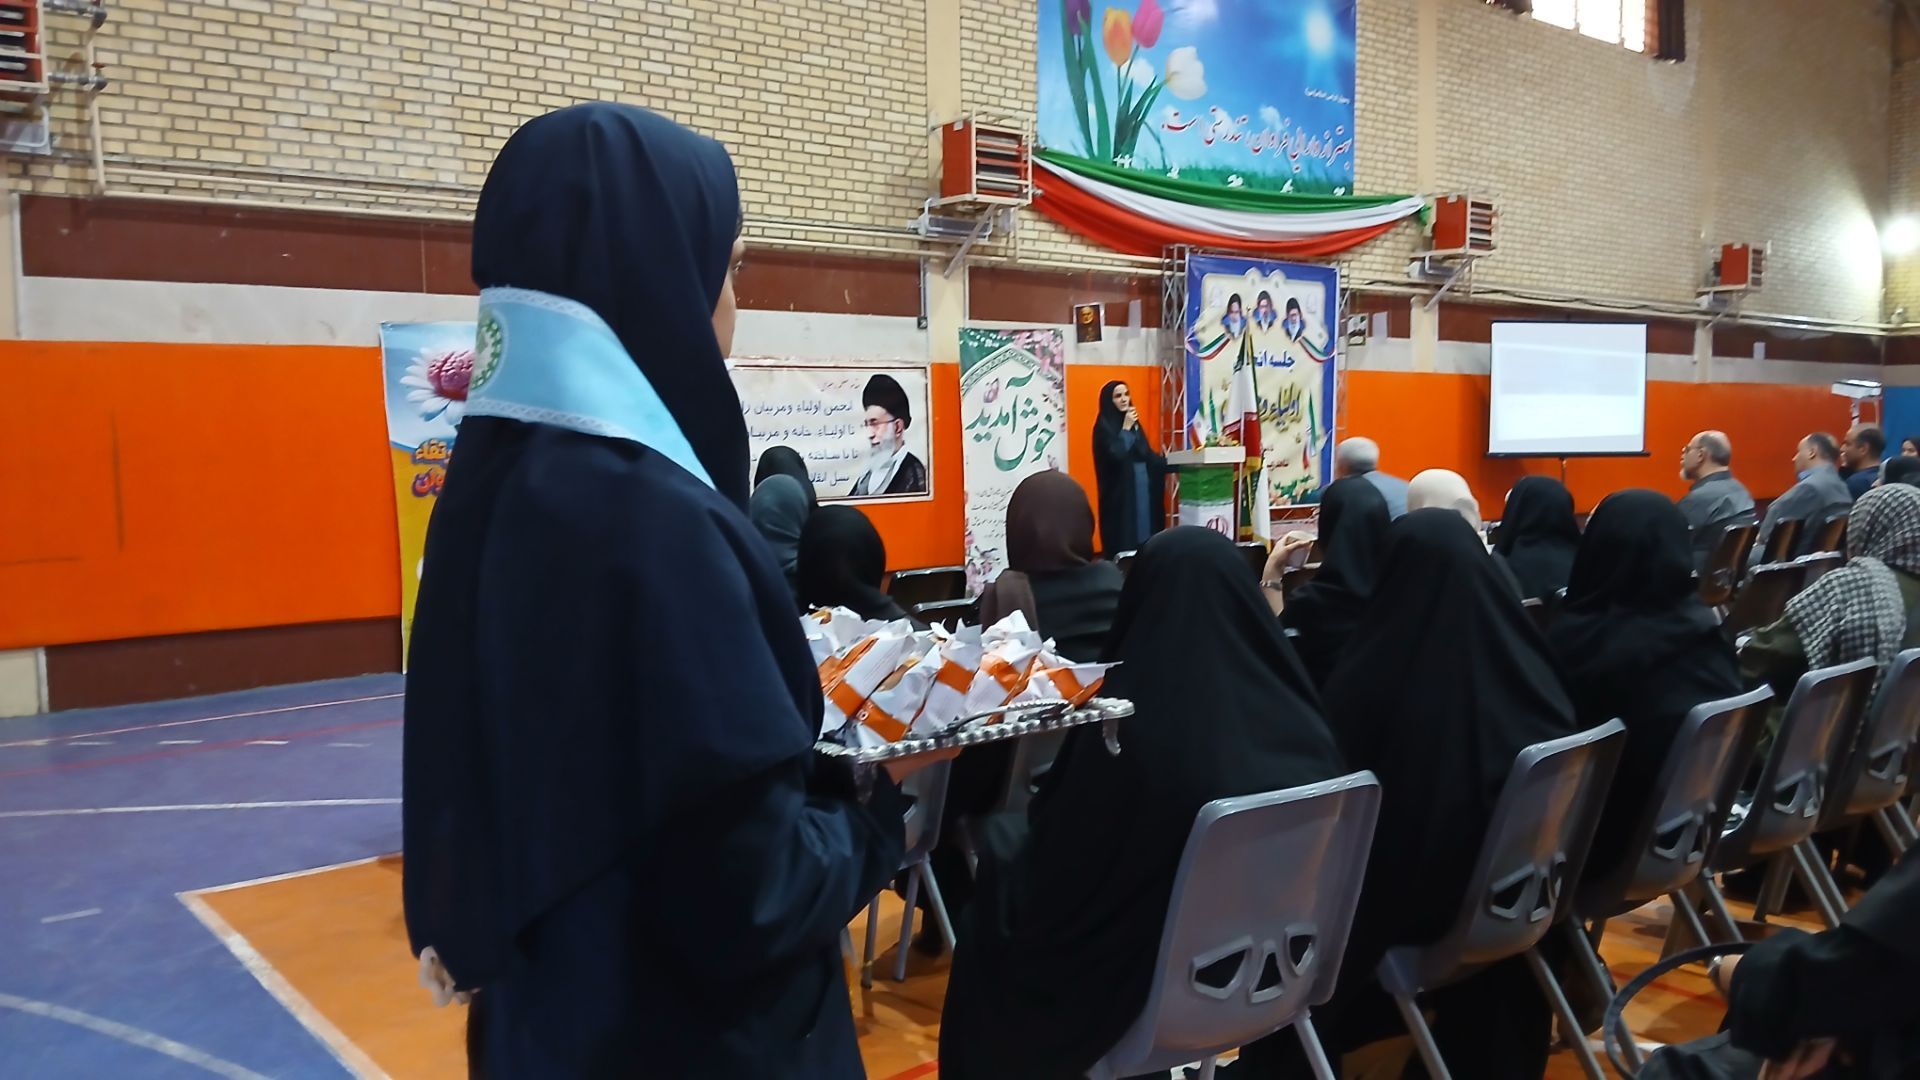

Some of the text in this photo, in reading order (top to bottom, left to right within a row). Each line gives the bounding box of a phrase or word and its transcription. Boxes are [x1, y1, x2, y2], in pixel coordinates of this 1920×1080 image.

[1270, 350, 1295, 372] جلسه
[965, 369, 1036, 443] آمدید
[994, 397, 1055, 472] خوش
